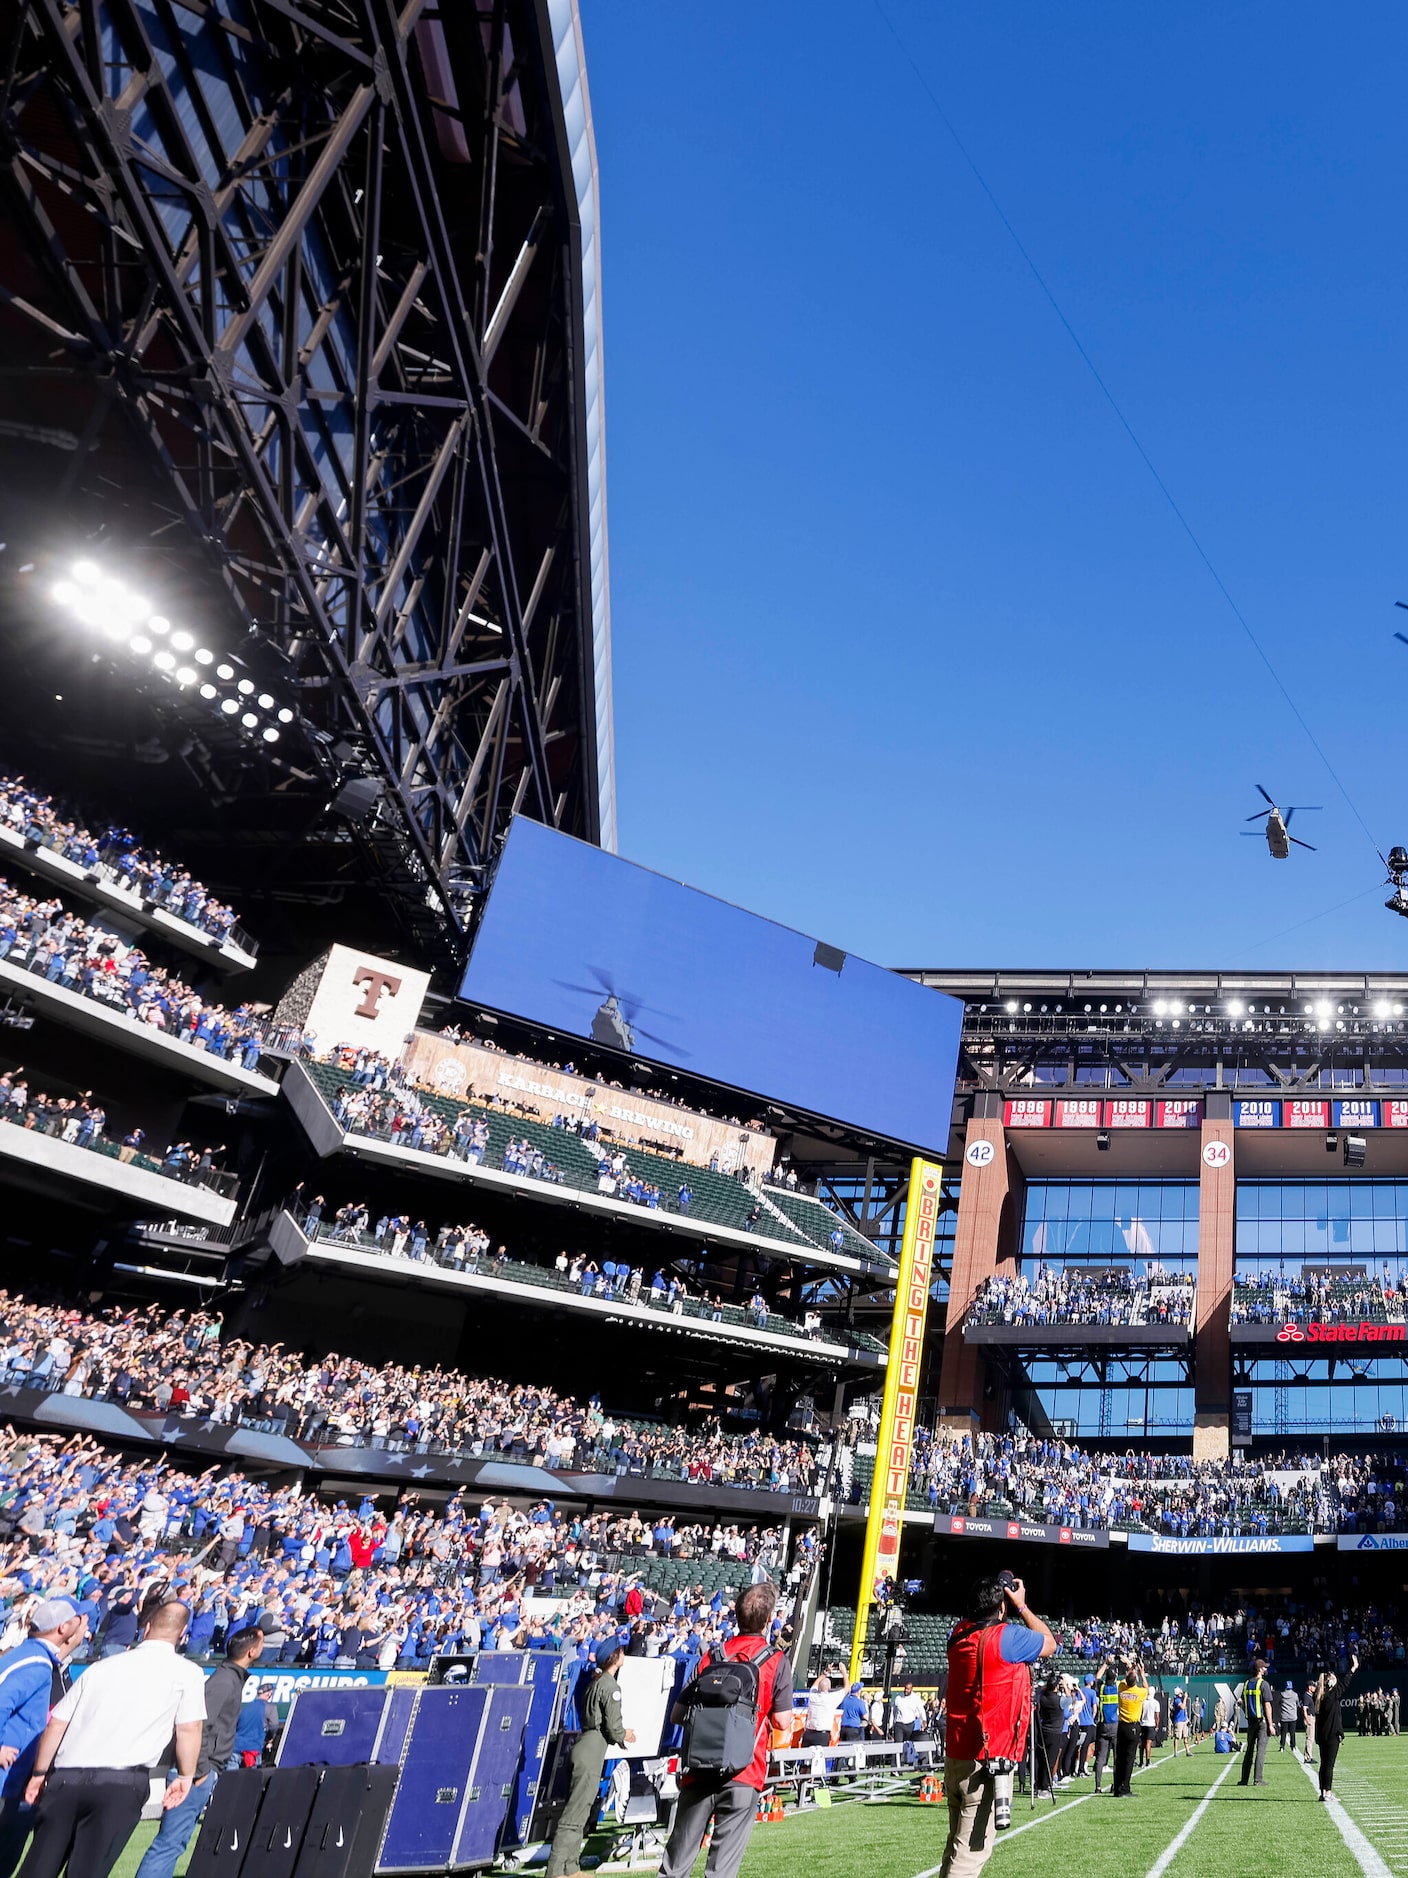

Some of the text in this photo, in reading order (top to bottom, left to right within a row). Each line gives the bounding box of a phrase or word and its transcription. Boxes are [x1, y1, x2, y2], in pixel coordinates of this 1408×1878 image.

[352, 966, 402, 1020] T
[497, 1071, 593, 1108] KARBACH
[608, 1105, 694, 1139] BREWING
[1011, 1100, 1045, 1114] 1996
[1062, 1100, 1097, 1114] 1998
[1112, 1100, 1147, 1114] 1999
[1164, 1100, 1197, 1114] 2010
[1240, 1100, 1272, 1114] 2010
[1292, 1100, 1322, 1114] 2011
[1342, 1100, 1371, 1114] 2011
[970, 1146, 990, 1160] 42
[1207, 1147, 1227, 1161] 34
[911, 1197, 933, 1308] BRING
[904, 1317, 921, 1385] THE
[890, 1396, 911, 1492] HEAT
[792, 1498, 817, 1513] 10:27
[965, 1521, 992, 1533] TOYOTA
[1020, 1527, 1046, 1537] TOYOTA
[1072, 1532, 1095, 1542] TOYOTA
